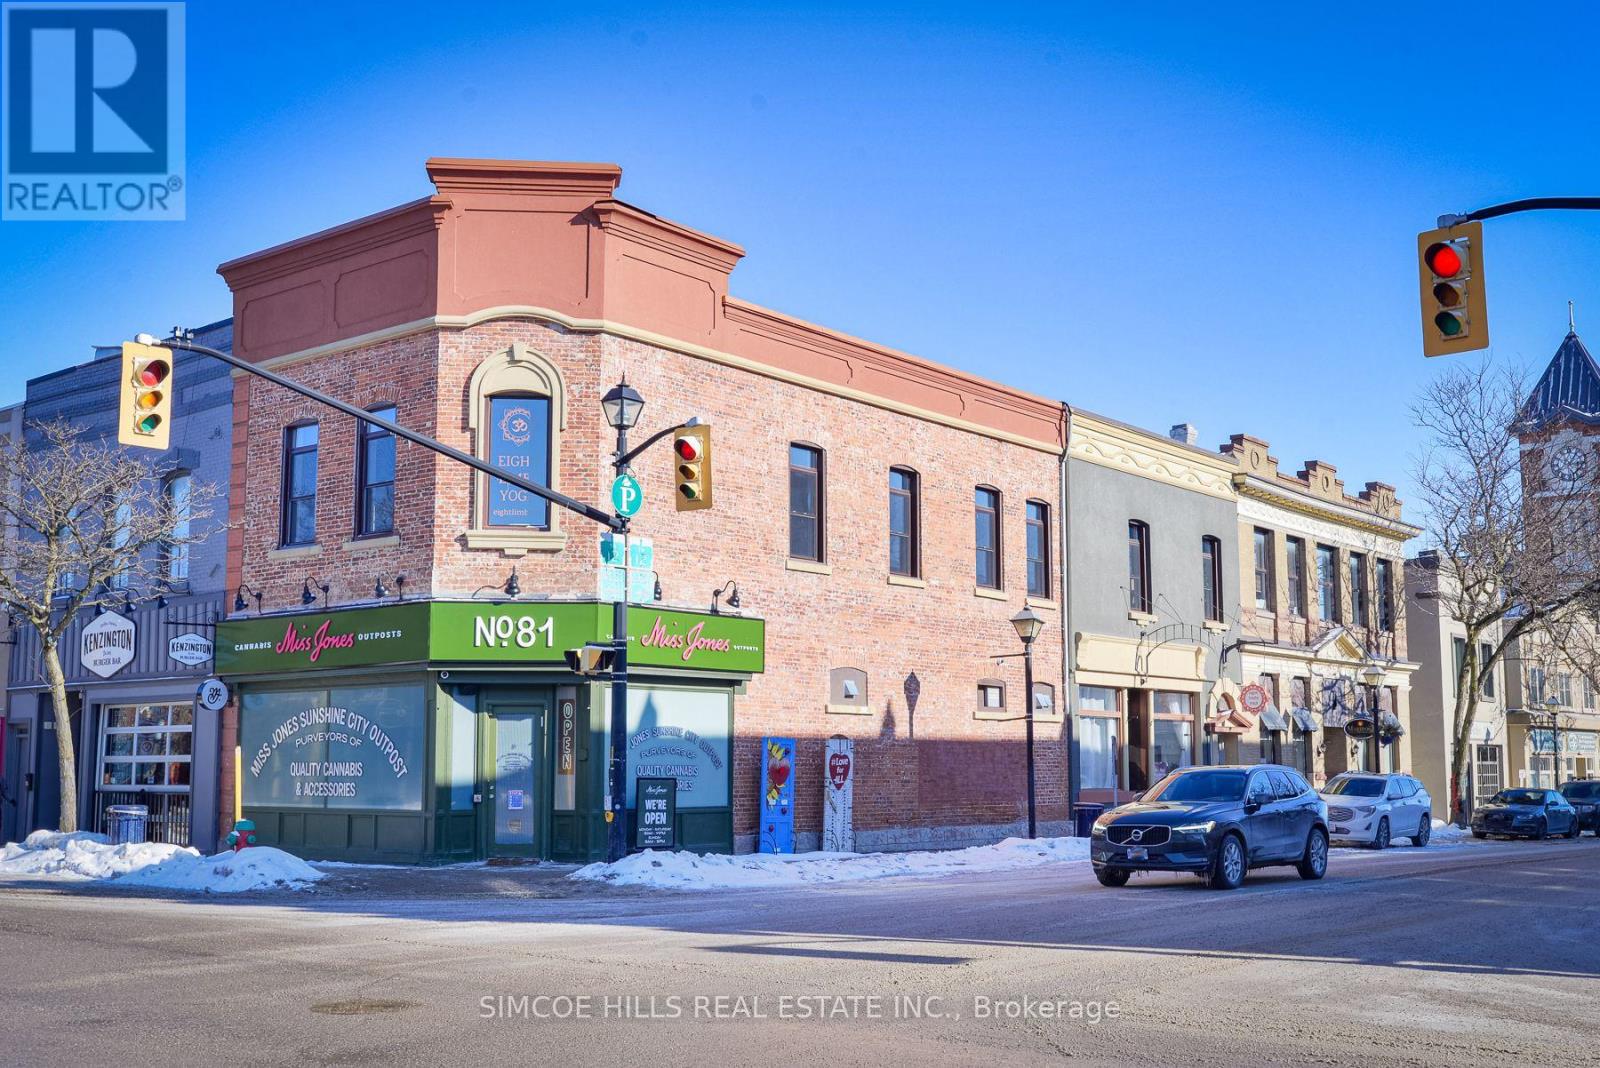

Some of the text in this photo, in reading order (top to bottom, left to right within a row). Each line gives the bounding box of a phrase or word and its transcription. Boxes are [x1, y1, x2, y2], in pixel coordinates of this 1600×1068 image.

[84, 629, 132, 656] KENZINGTON
[234, 619, 402, 662] CANNABIS Miss Jones OUTPOSTS
[640, 615, 684, 648] Miss
[681, 620, 730, 661] Jones
[171, 641, 212, 655] KENZINGTON
[250, 707, 408, 779] MISS JONES SUNSHINE CITY OUTPOST
[295, 731, 363, 748] PURVEYORS OF
[562, 702, 574, 770] OPEN
[630, 729, 650, 749] JONES
[652, 726, 684, 738] SUNSHINE
[290, 761, 363, 777] QUALITY CANNABIS
[637, 764, 699, 777] QUALITY CANNABIS
[836, 766, 844, 774] for
[295, 782, 356, 797] & ACCESSORIES
[645, 799, 667, 810] WE'RE
[644, 812, 667, 825] OPEN
